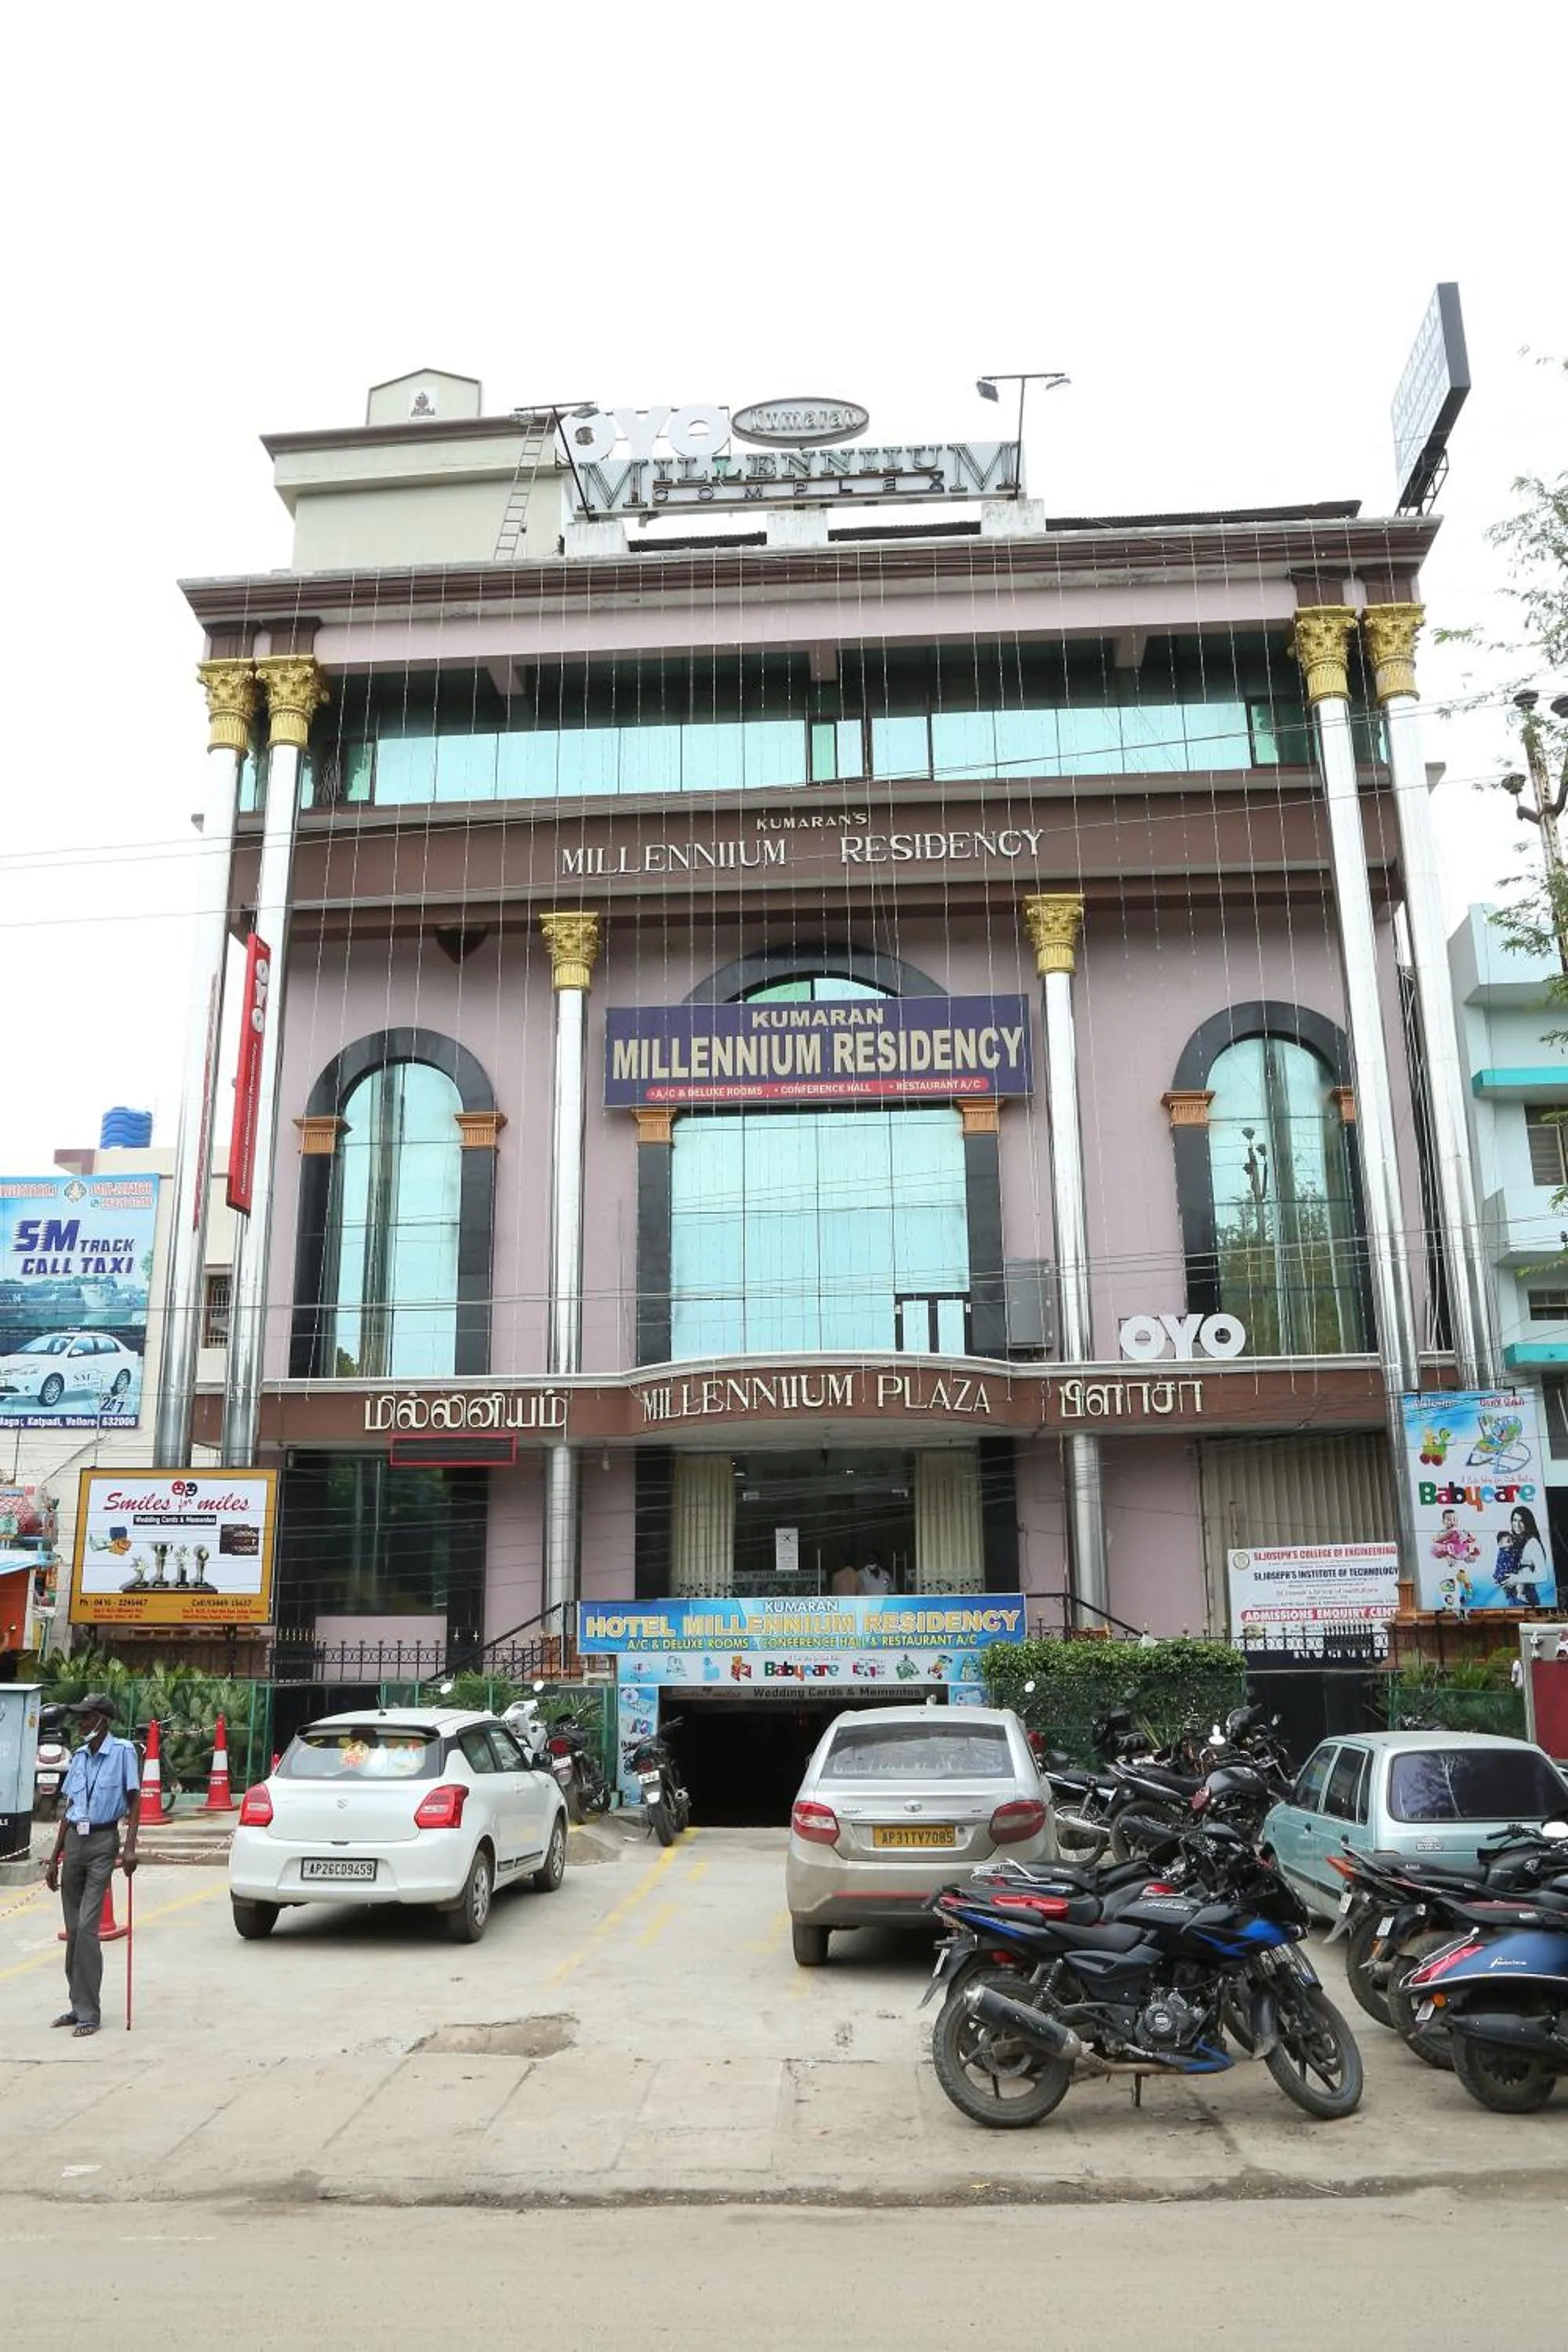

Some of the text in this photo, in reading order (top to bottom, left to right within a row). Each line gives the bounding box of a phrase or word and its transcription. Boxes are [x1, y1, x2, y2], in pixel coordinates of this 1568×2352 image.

[554, 405, 730, 464] OYO
[652, 472, 945, 502] COMPLEX
[756, 812, 869, 831] KUMARAN'S
[840, 829, 1044, 863] RESIDENCY
[252, 960, 269, 1033] OYO
[752, 1007, 884, 1028] KUMARAN
[612, 1025, 1024, 1080] MILLENNIUM RESIDENCY
[688, 1087, 724, 1098] DELUXE
[727, 1085, 763, 1095] ROOMS
[780, 1083, 844, 1094] CONFERENCE
[847, 1083, 872, 1092] HALL
[896, 1079, 958, 1091] RESTAURANT
[12, 1219, 135, 1253] SM TRACK
[21, 1257, 134, 1276] CALL TAXI
[1120, 1313, 1247, 1359] OYO
[877, 1374, 992, 1414] PLAZA
[103, 1492, 250, 1512] Smiles for miles
[1419, 1481, 1536, 1512] Babycare
[764, 1600, 839, 1613] KUMARAN
[1246, 1610, 1313, 1621] ADMISSIONS
[586, 1610, 1021, 1637] HOTEL MILLENNIUM RESIDENCY
[652, 1639, 661, 1650] &
[662, 1639, 703, 1650] DELUXE
[709, 1638, 750, 1649] ROOMS
[881, 1634, 952, 1646] RESTAURANT
[764, 1661, 840, 1681] Babycare
[753, 1688, 805, 1698] Wedding
[808, 1686, 843, 1697] Cards
